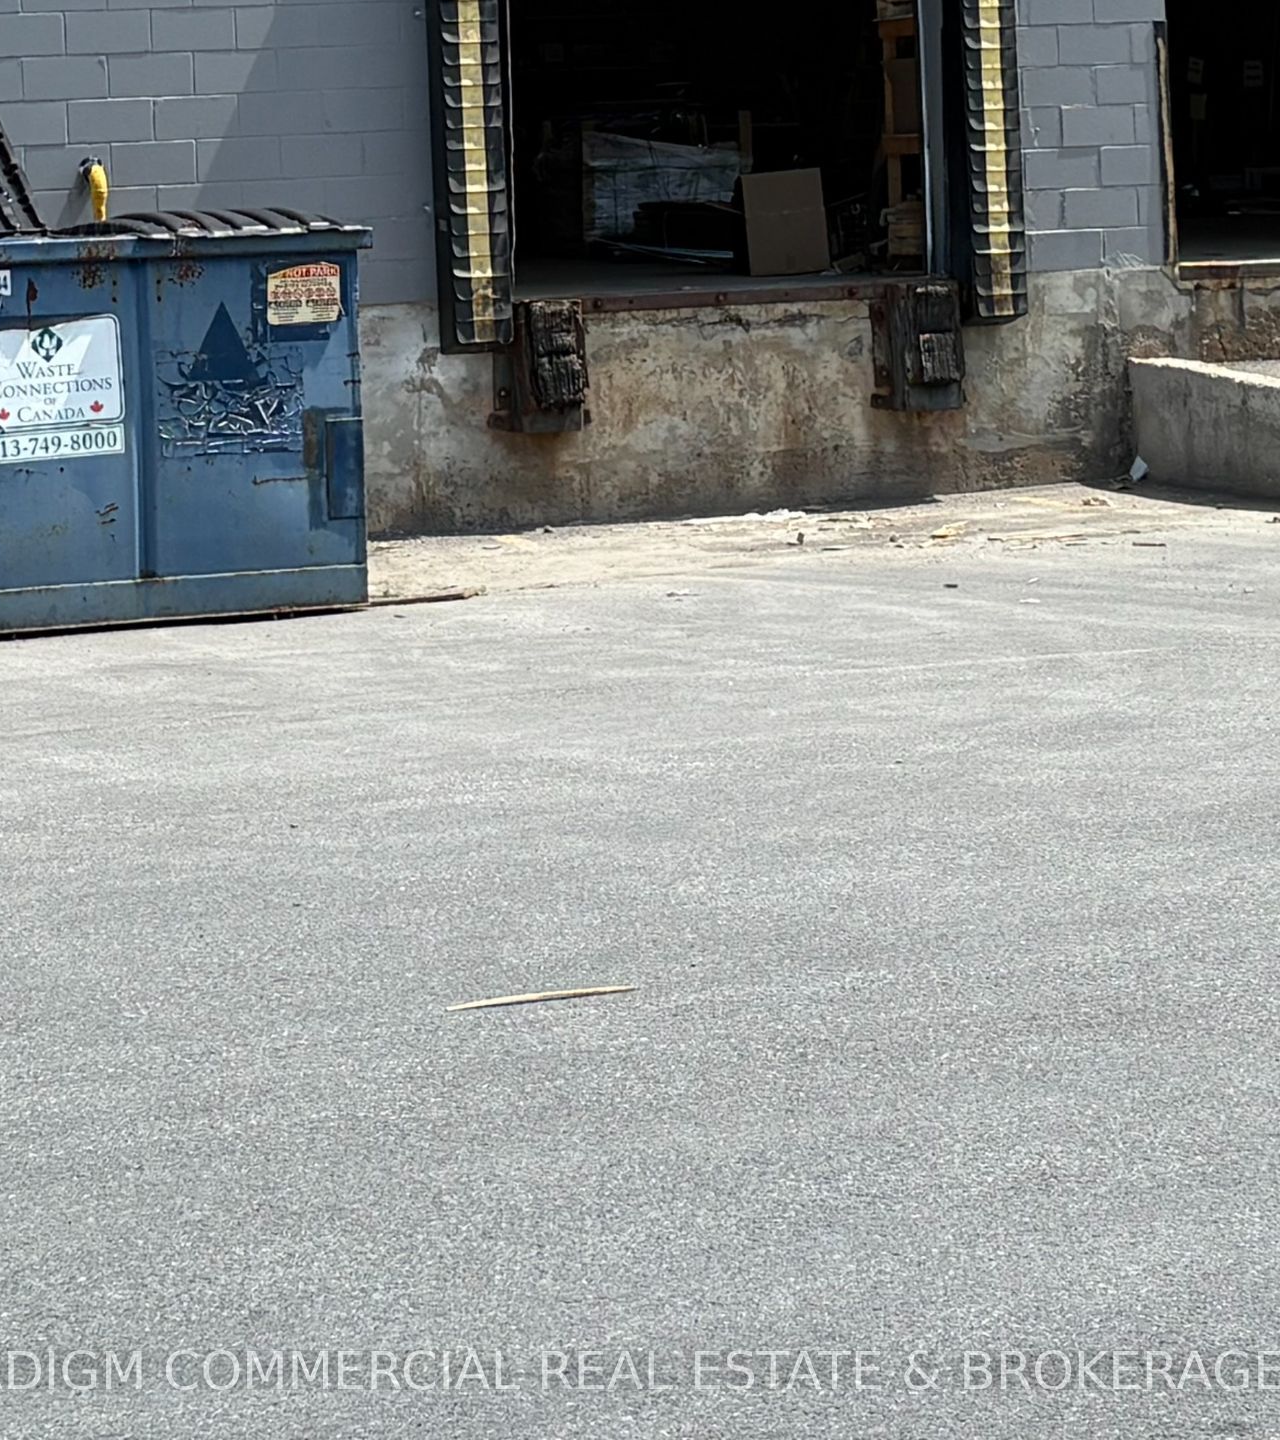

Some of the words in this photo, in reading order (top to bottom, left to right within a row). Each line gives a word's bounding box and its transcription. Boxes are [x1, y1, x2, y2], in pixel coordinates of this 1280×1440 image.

[310, 266, 338, 277] PARK
[16, 361, 76, 380] WASTE
[17, 407, 86, 423] CANADA
